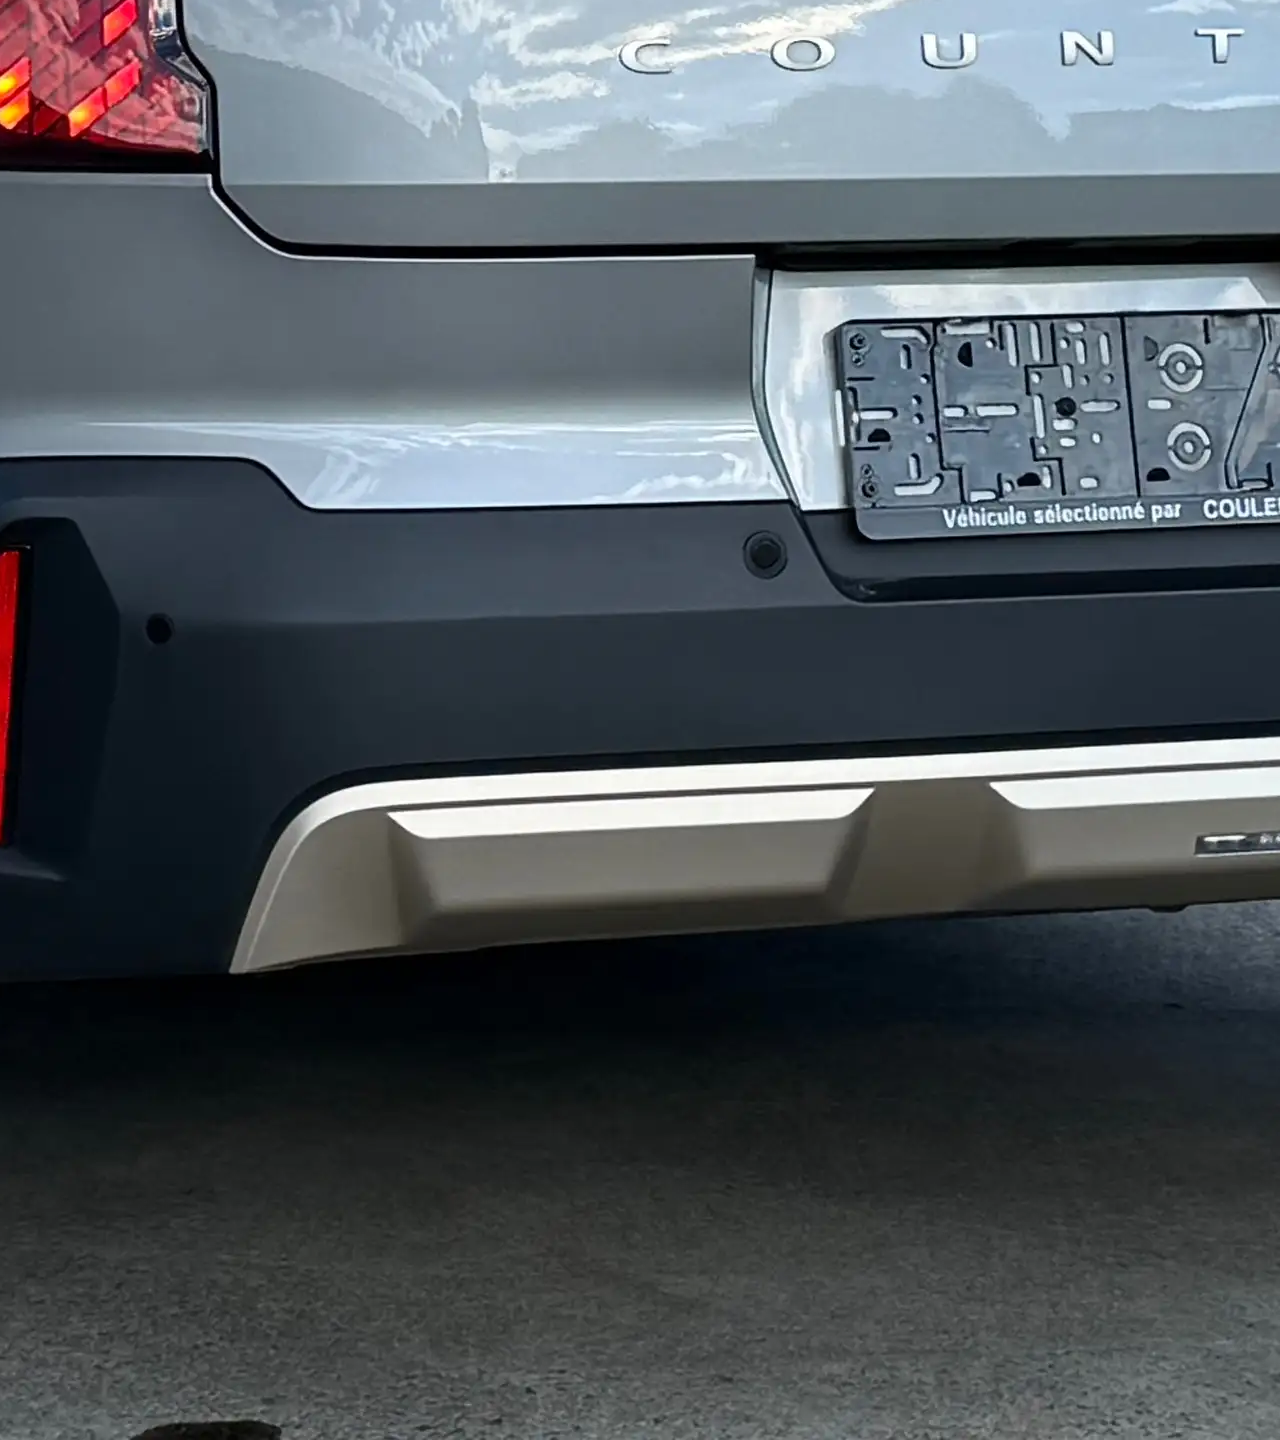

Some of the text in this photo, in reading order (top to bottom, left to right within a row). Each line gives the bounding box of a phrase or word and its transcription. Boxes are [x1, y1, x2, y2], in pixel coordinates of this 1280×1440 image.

[943, 505, 1027, 529] Véhicule
[1034, 501, 1145, 524] sélectionné
[1151, 503, 1182, 523] par
